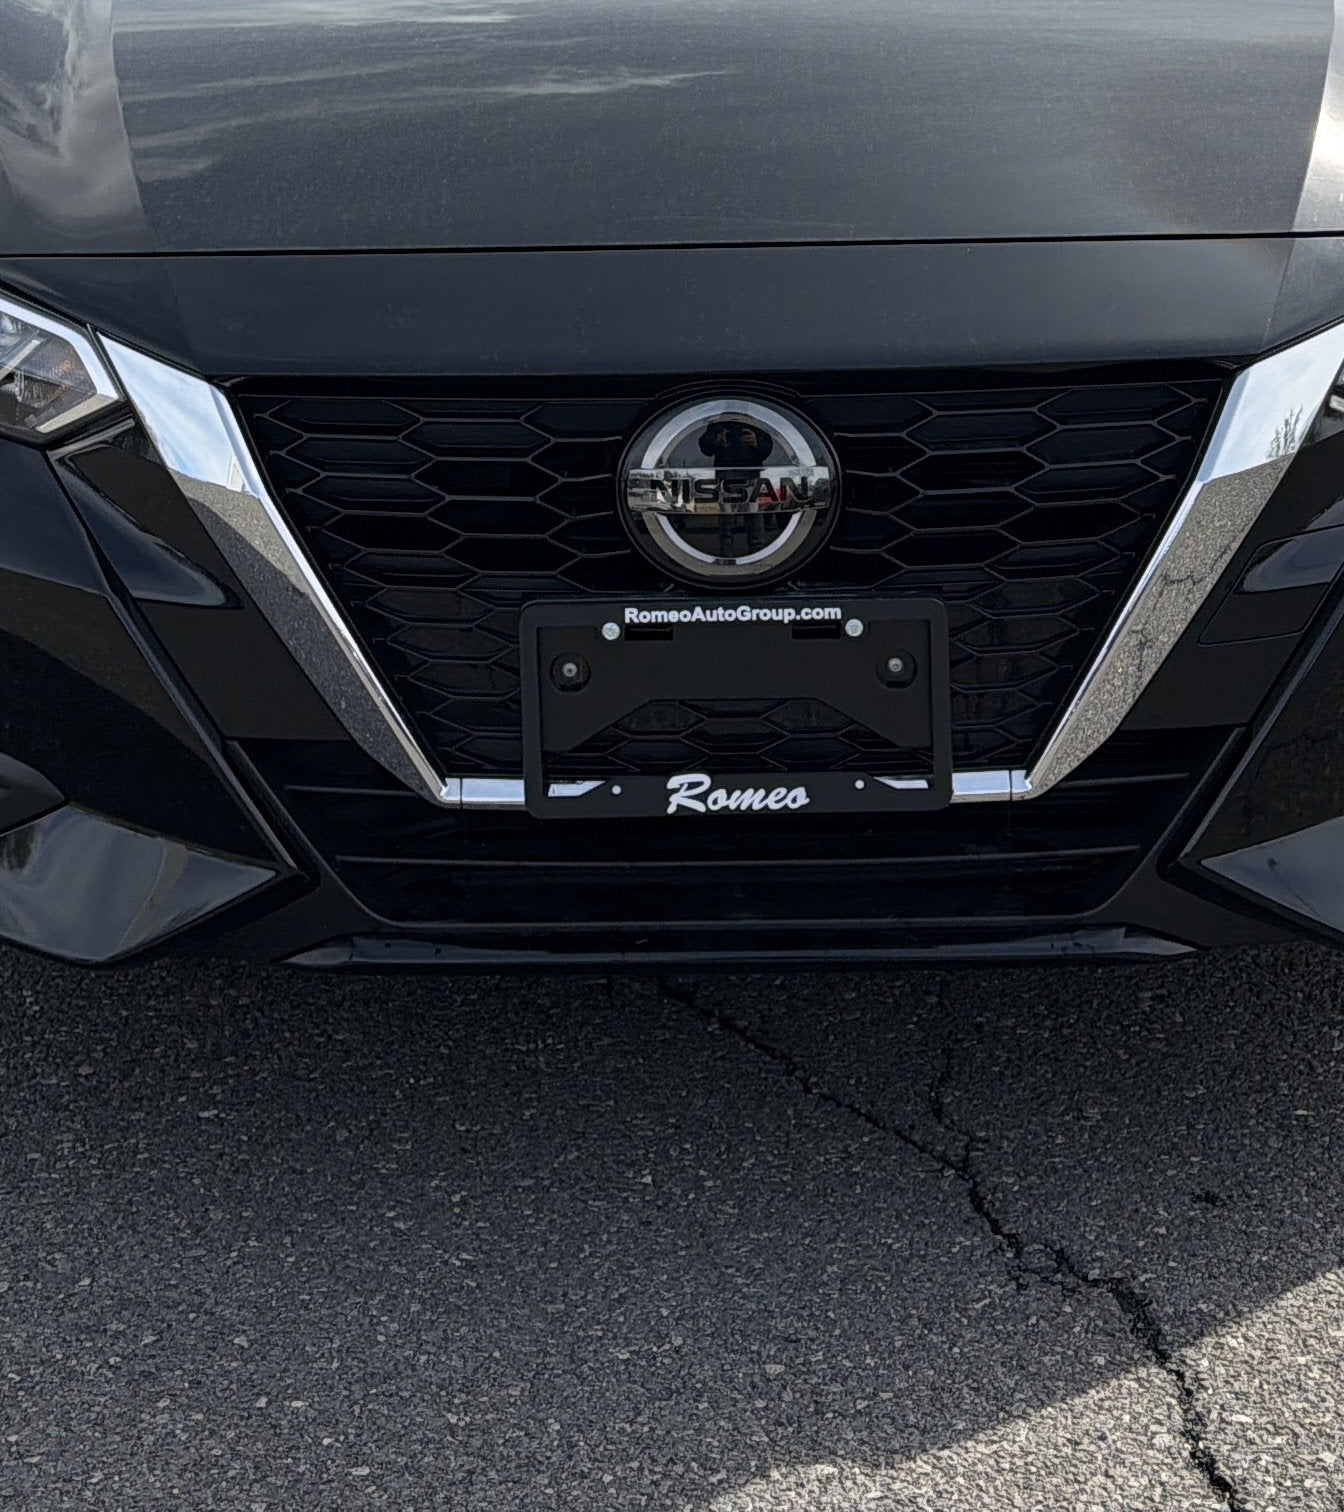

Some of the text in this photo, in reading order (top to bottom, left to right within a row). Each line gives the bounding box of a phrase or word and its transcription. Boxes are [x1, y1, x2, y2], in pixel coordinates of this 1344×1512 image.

[650, 474, 810, 505] NISSAN
[624, 605, 842, 624] RomeoAutoGroup.com
[666, 773, 810, 815] Romeo
